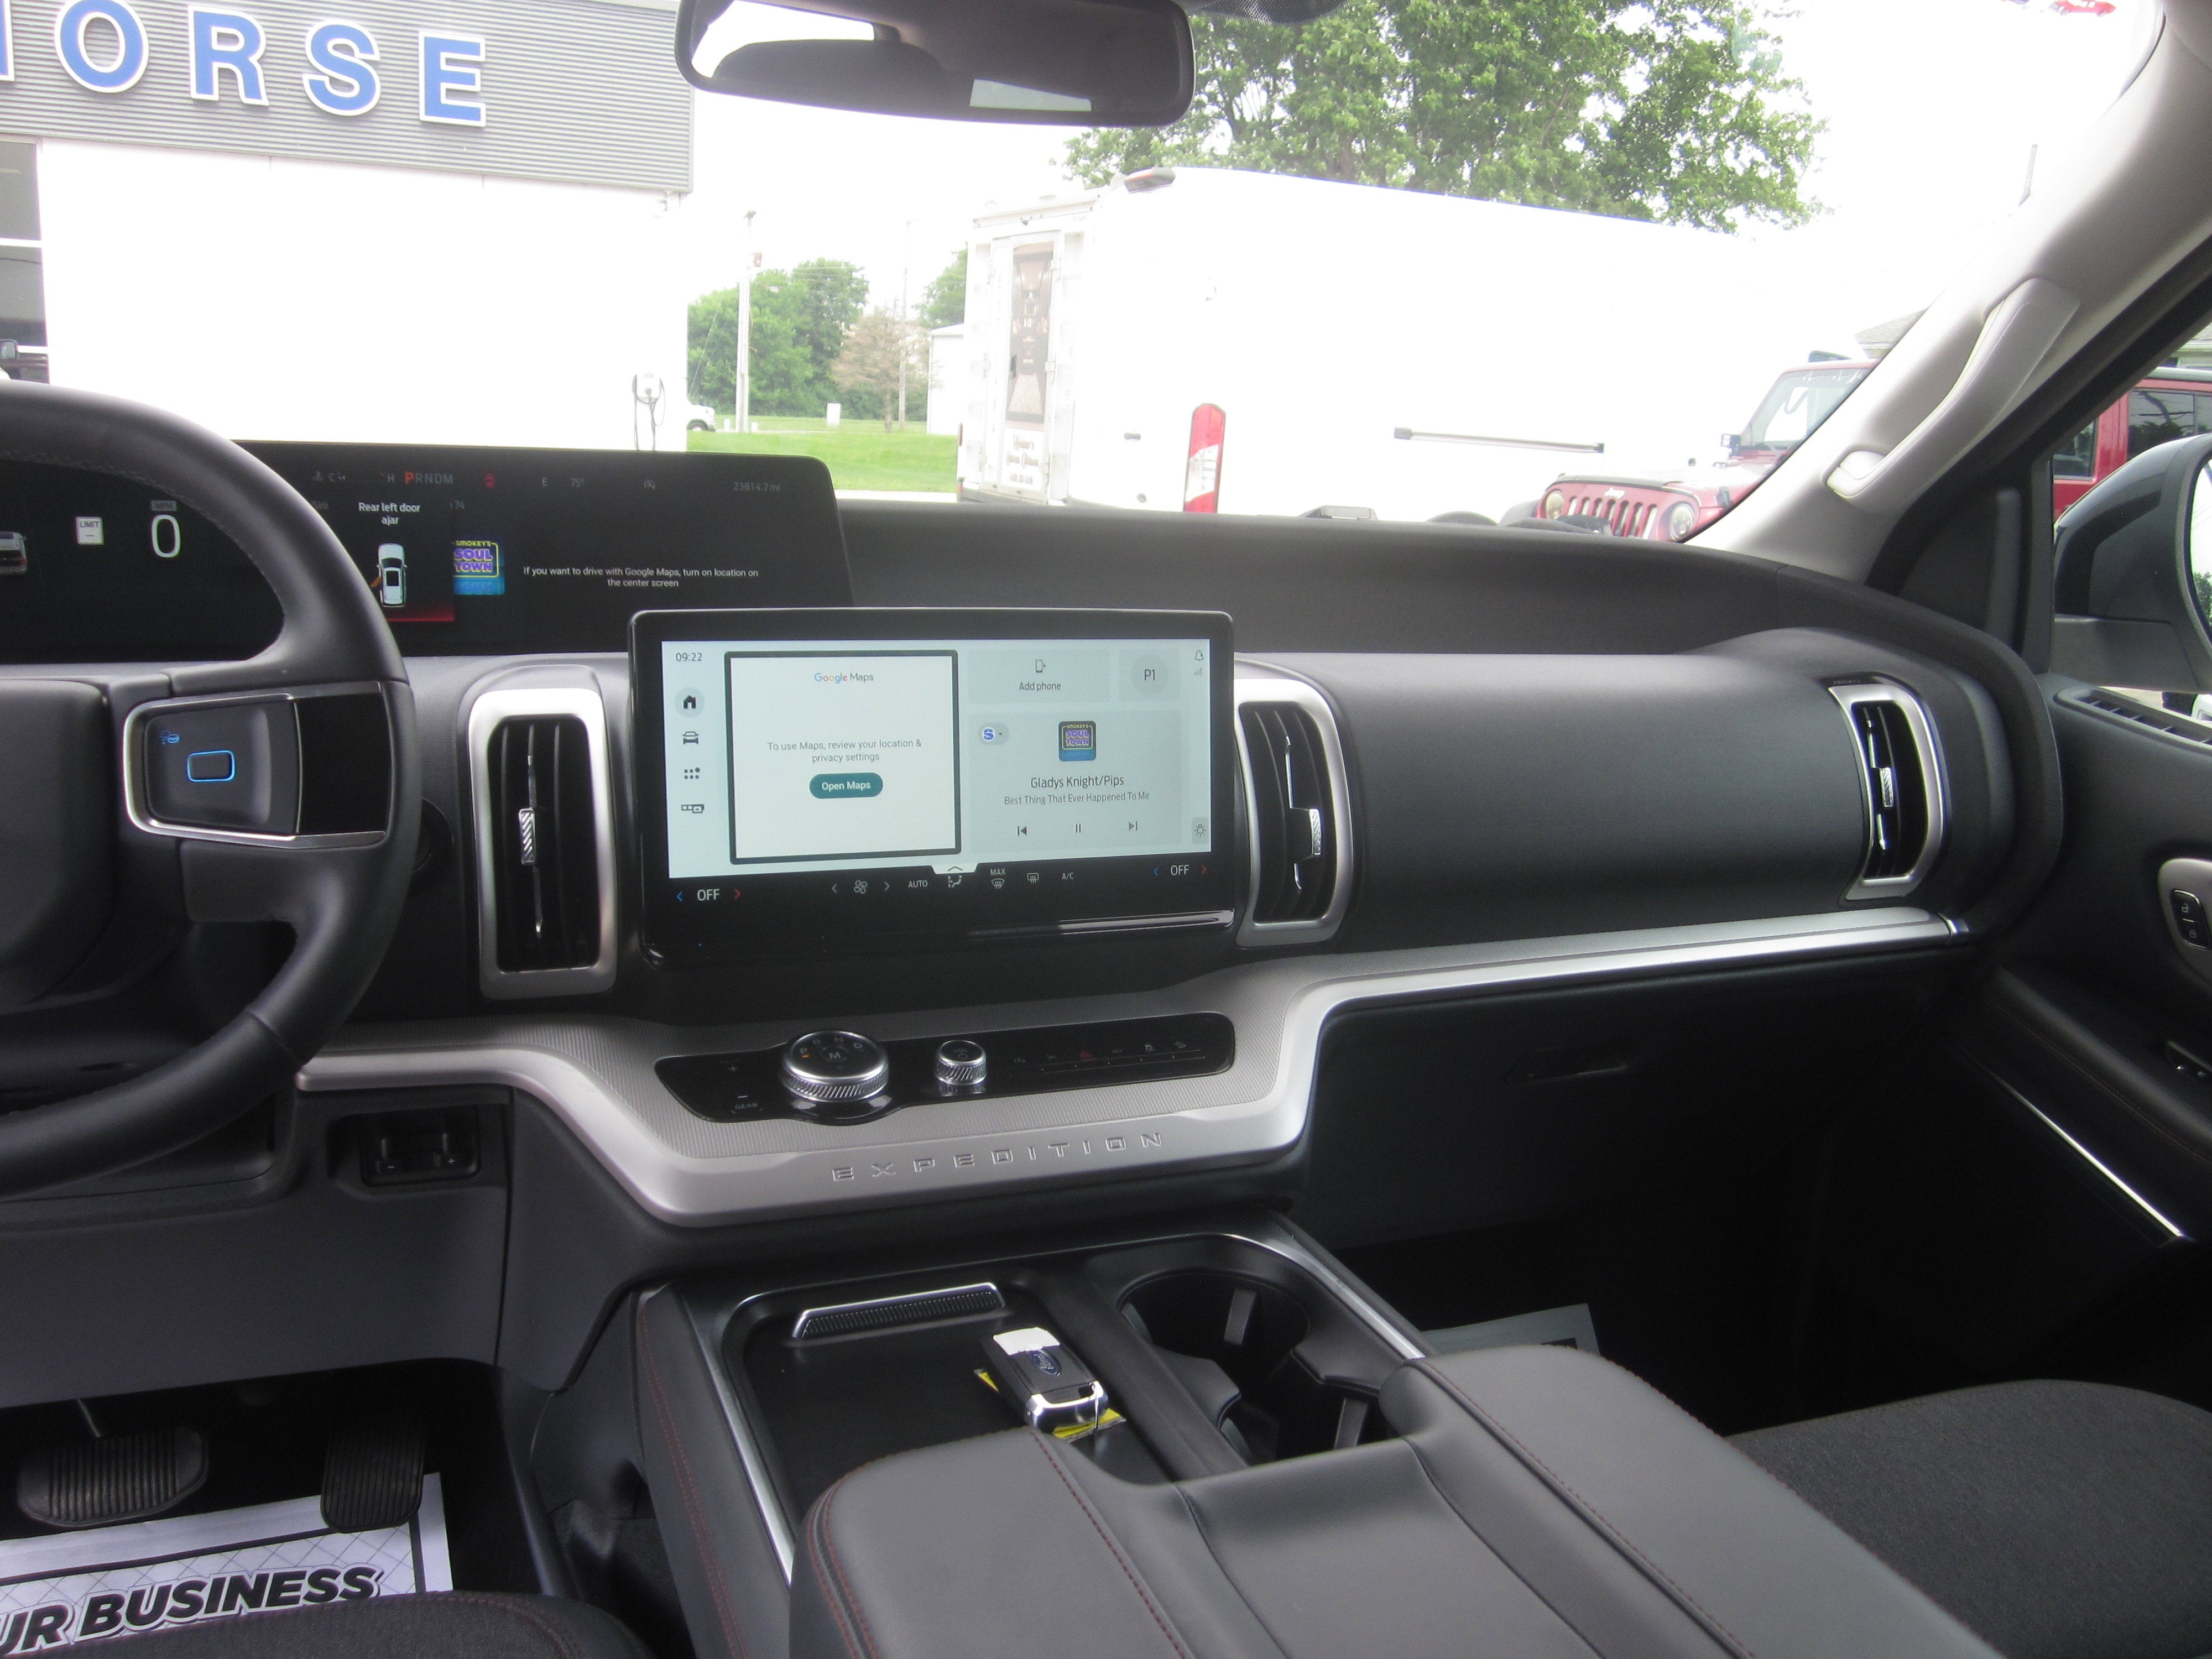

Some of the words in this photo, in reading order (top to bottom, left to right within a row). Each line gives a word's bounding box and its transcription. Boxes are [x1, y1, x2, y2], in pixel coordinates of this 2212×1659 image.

[0, 0, 487, 127] ORSE
[358, 502, 379, 512] Rear
[381, 502, 398, 512] left
[399, 503, 420, 513] door
[381, 515, 399, 525] ajar
[152, 514, 181, 557] 0
[453, 548, 493, 561] SOUL
[453, 561, 493, 573] TOWN
[523, 566, 530, 575] If
[532, 568, 547, 576] you
[583, 567, 603, 575] drive
[605, 567, 623, 576] with
[625, 567, 654, 577] Google
[656, 568, 681, 577] Maps,
[714, 568, 746, 576] location
[675, 653, 702, 662] 09:22
[814, 672, 848, 684] Google
[849, 672, 874, 682] Maps
[1144, 669, 1156, 681] P1
[1019, 682, 1035, 690] Add
[1036, 681, 1061, 692] phone
[1065, 729, 1089, 739] SOUL
[767, 742, 779, 750] To
[799, 742, 826, 751] Maps,
[828, 741, 855, 749] review
[858, 741, 877, 750] your
[879, 739, 914, 748] location
[916, 739, 922, 747] &
[1065, 738, 1089, 747] TOWN
[812, 753, 842, 764] privacy
[845, 752, 880, 763] settings
[821, 781, 845, 792] Open
[847, 781, 872, 791] Maps
[1030, 777, 1064, 789] Gladys
[1066, 775, 1125, 789] Knight/Pips
[1004, 796, 1022, 805] Best
[1024, 795, 1046, 805] Thing
[1048, 794, 1066, 803] That
[1068, 794, 1084, 802] Ever
[1086, 792, 1126, 803] Happened
[1128, 792, 1136, 800] To
[1138, 791, 1150, 800] Me
[1170, 864, 1190, 876] OFF
[908, 879, 928, 888] AUTO
[697, 888, 720, 901] OFF
[832, 1133, 1162, 1182] EXPEDITION
[79, 1566, 382, 1637] BUSINESS
